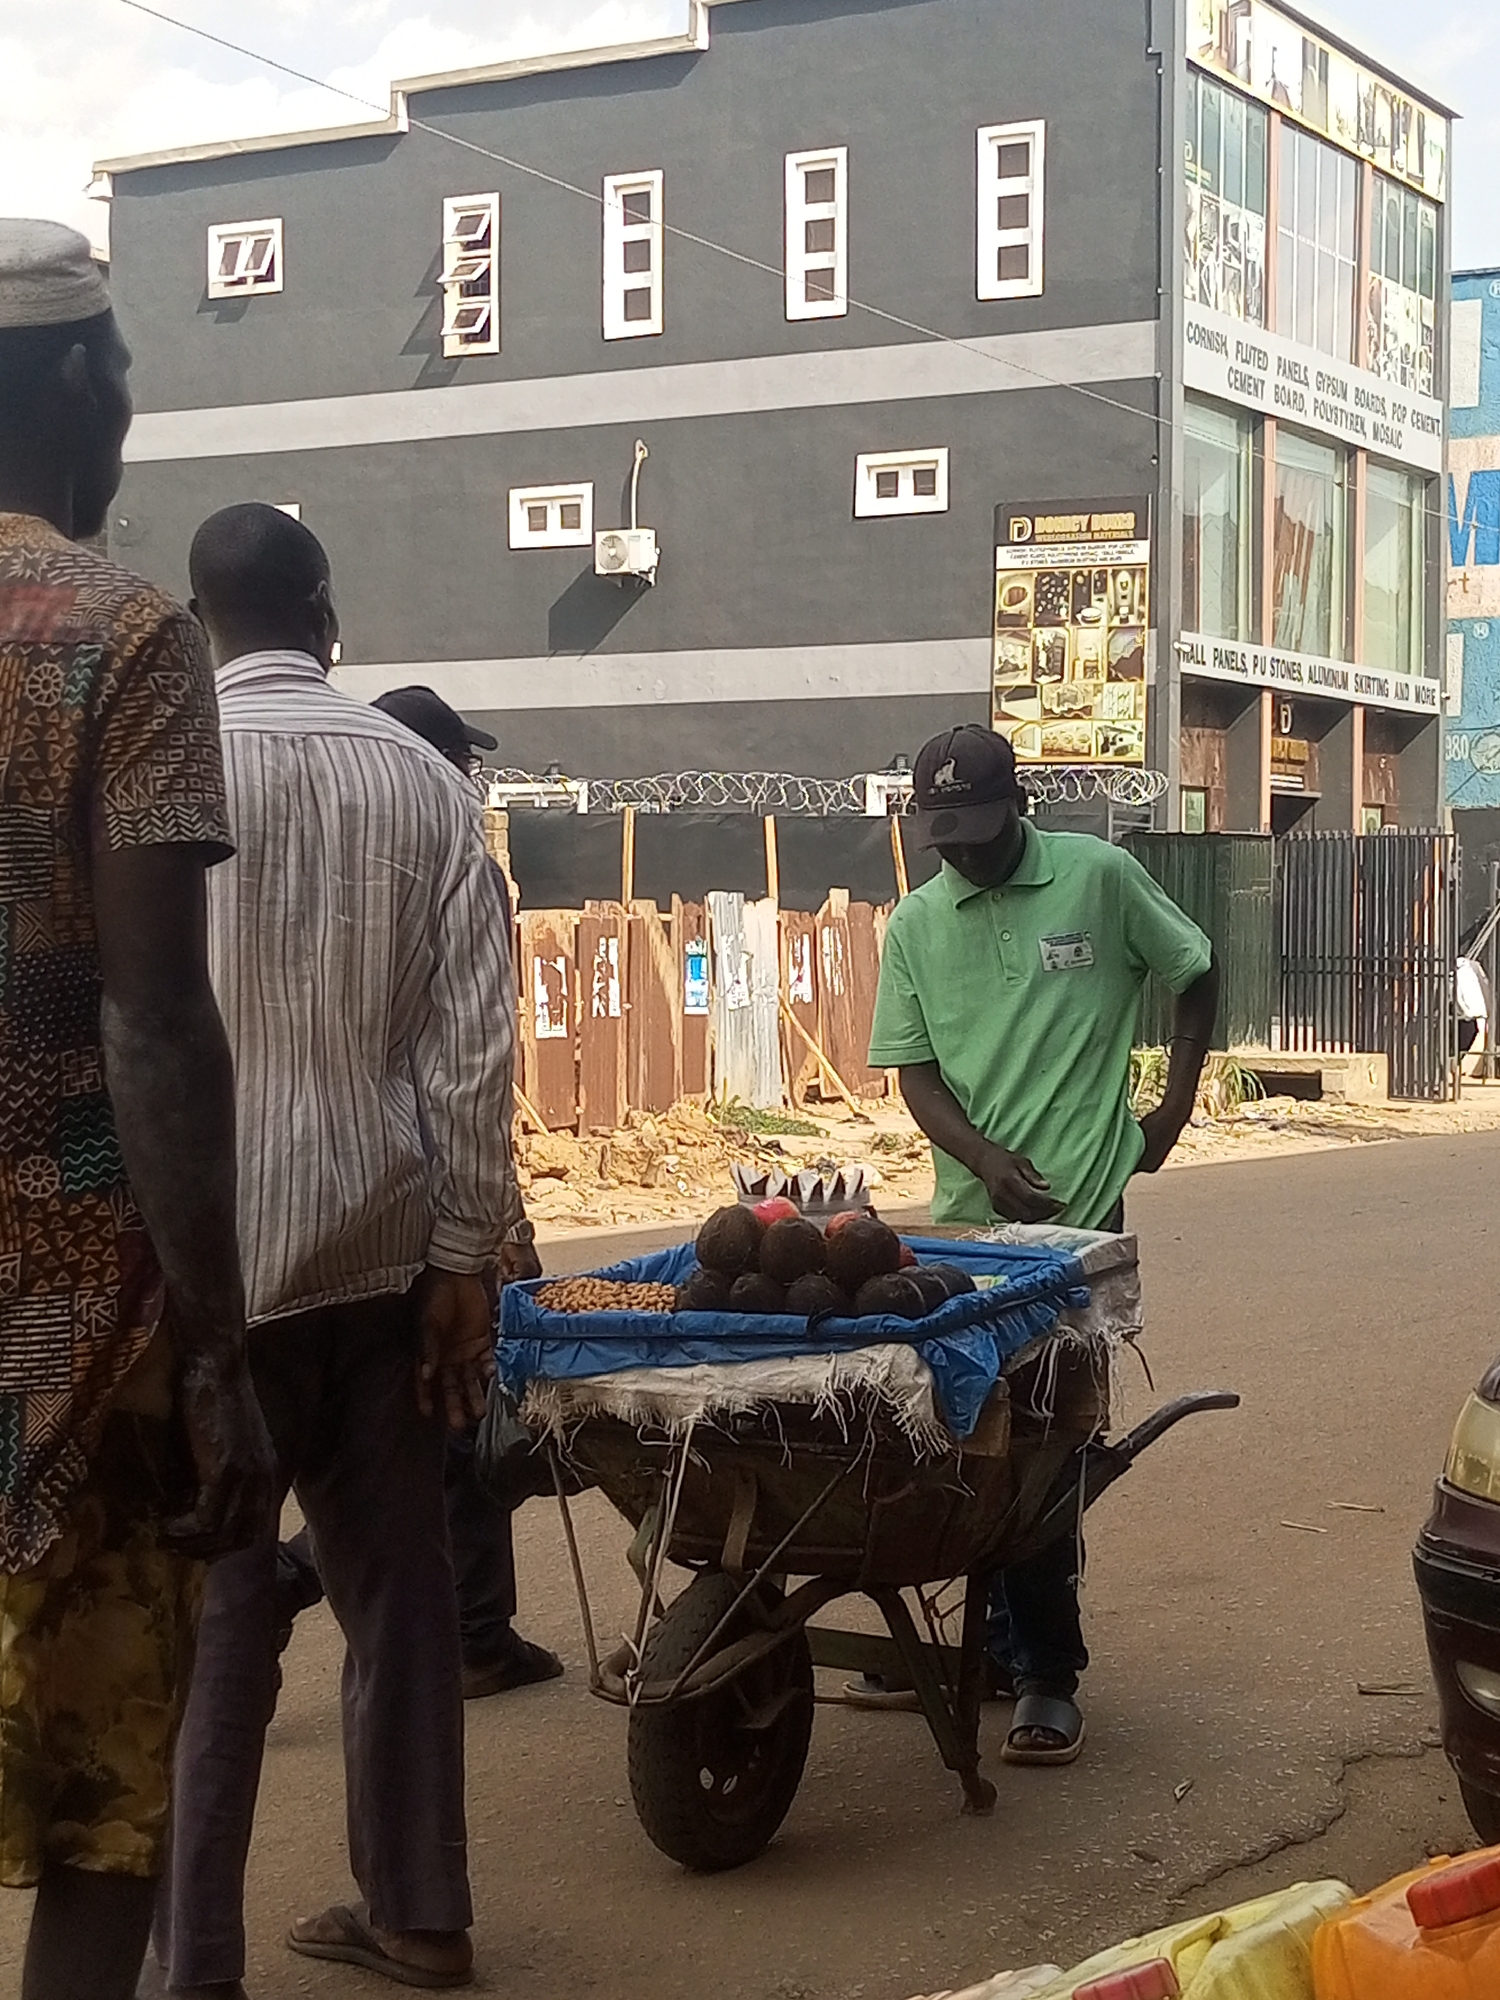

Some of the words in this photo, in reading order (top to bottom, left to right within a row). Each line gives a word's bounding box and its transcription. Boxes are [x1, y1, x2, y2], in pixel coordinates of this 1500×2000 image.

[1186, 321, 1229, 360] CORNISH,
[1235, 340, 1269, 371] FLUTED
[1276, 355, 1310, 391] PANELS,
[1315, 371, 1348, 402] GYPSUM
[1227, 366, 1266, 401] CEMENT
[1274, 383, 1308, 417] BOARD,
[1372, 421, 1403, 450] MOSAIC
[1213, 647, 1249, 678] PANELS,
[1269, 656, 1304, 686] STONES,
[1354, 672, 1389, 699] SKIRTING
[1394, 681, 1410, 701] AND
[1415, 684, 1437, 706] MORE
